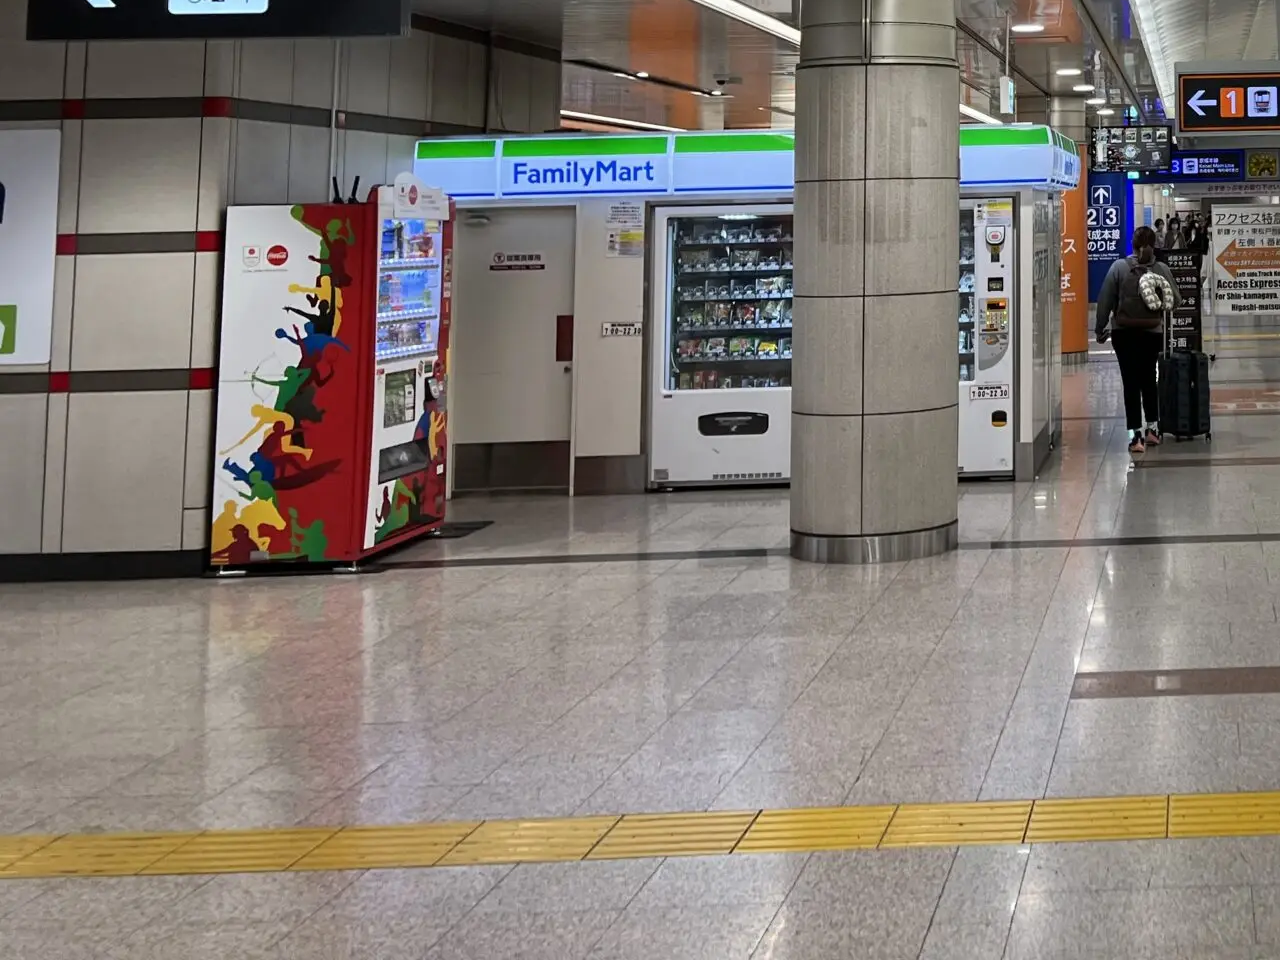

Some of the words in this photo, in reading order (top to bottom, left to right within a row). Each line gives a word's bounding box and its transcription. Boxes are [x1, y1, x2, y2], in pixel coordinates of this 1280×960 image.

[1226, 90, 1237, 114] 1
[513, 160, 654, 186] FamilyMart
[1087, 208, 1097, 225] 2
[1106, 208, 1117, 225] 3
[1087, 240, 1117, 252] のりば
[1217, 280, 1248, 289] Access
